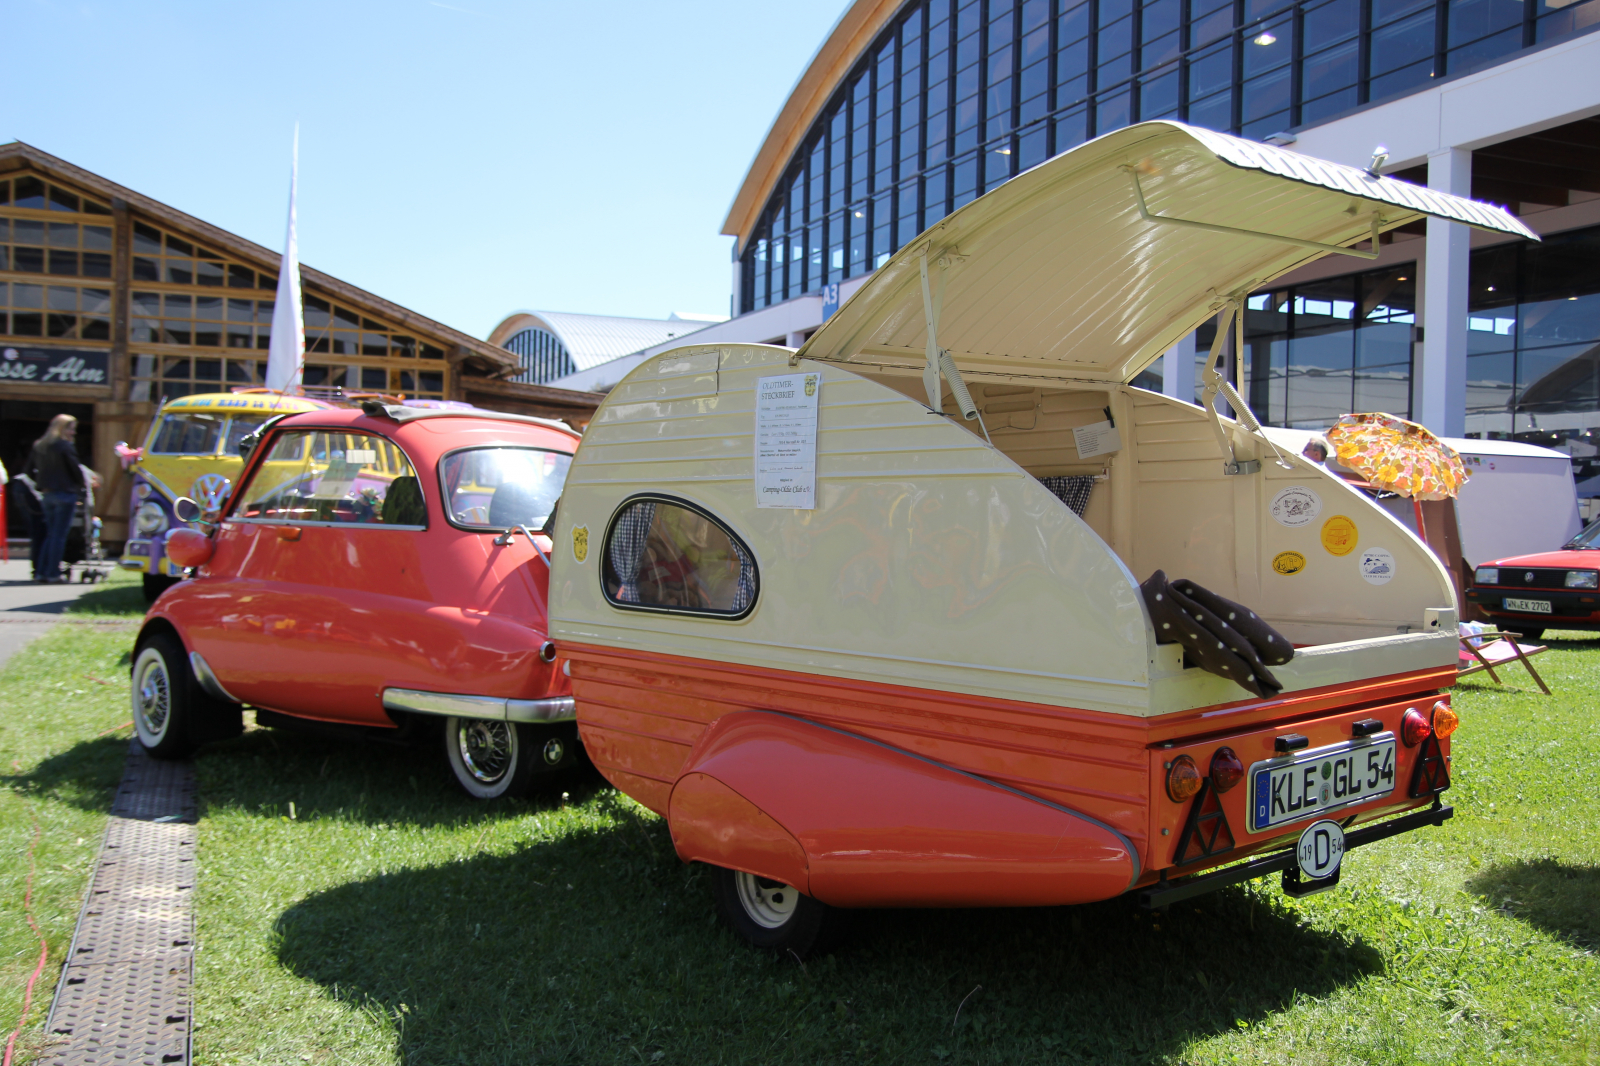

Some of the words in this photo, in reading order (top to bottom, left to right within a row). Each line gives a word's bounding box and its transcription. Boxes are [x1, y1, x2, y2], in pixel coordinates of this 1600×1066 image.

[822, 283, 838, 307] A3
[41, 356, 105, 382] Alm
[762, 380, 794, 390] OLDTIMER-
[761, 390, 795, 400] STECKBRIEF
[792, 485, 803, 494] Club
[1520, 601, 1530, 610] EK
[1531, 602, 1550, 611] 2702
[1270, 765, 1317, 818] KLE
[1333, 756, 1362, 798] GL
[1367, 747, 1394, 789] 54
[1260, 805, 1266, 816] D
[1303, 843, 1312, 861] 19
[1314, 828, 1330, 870] D
[1332, 837, 1342, 854] 54
